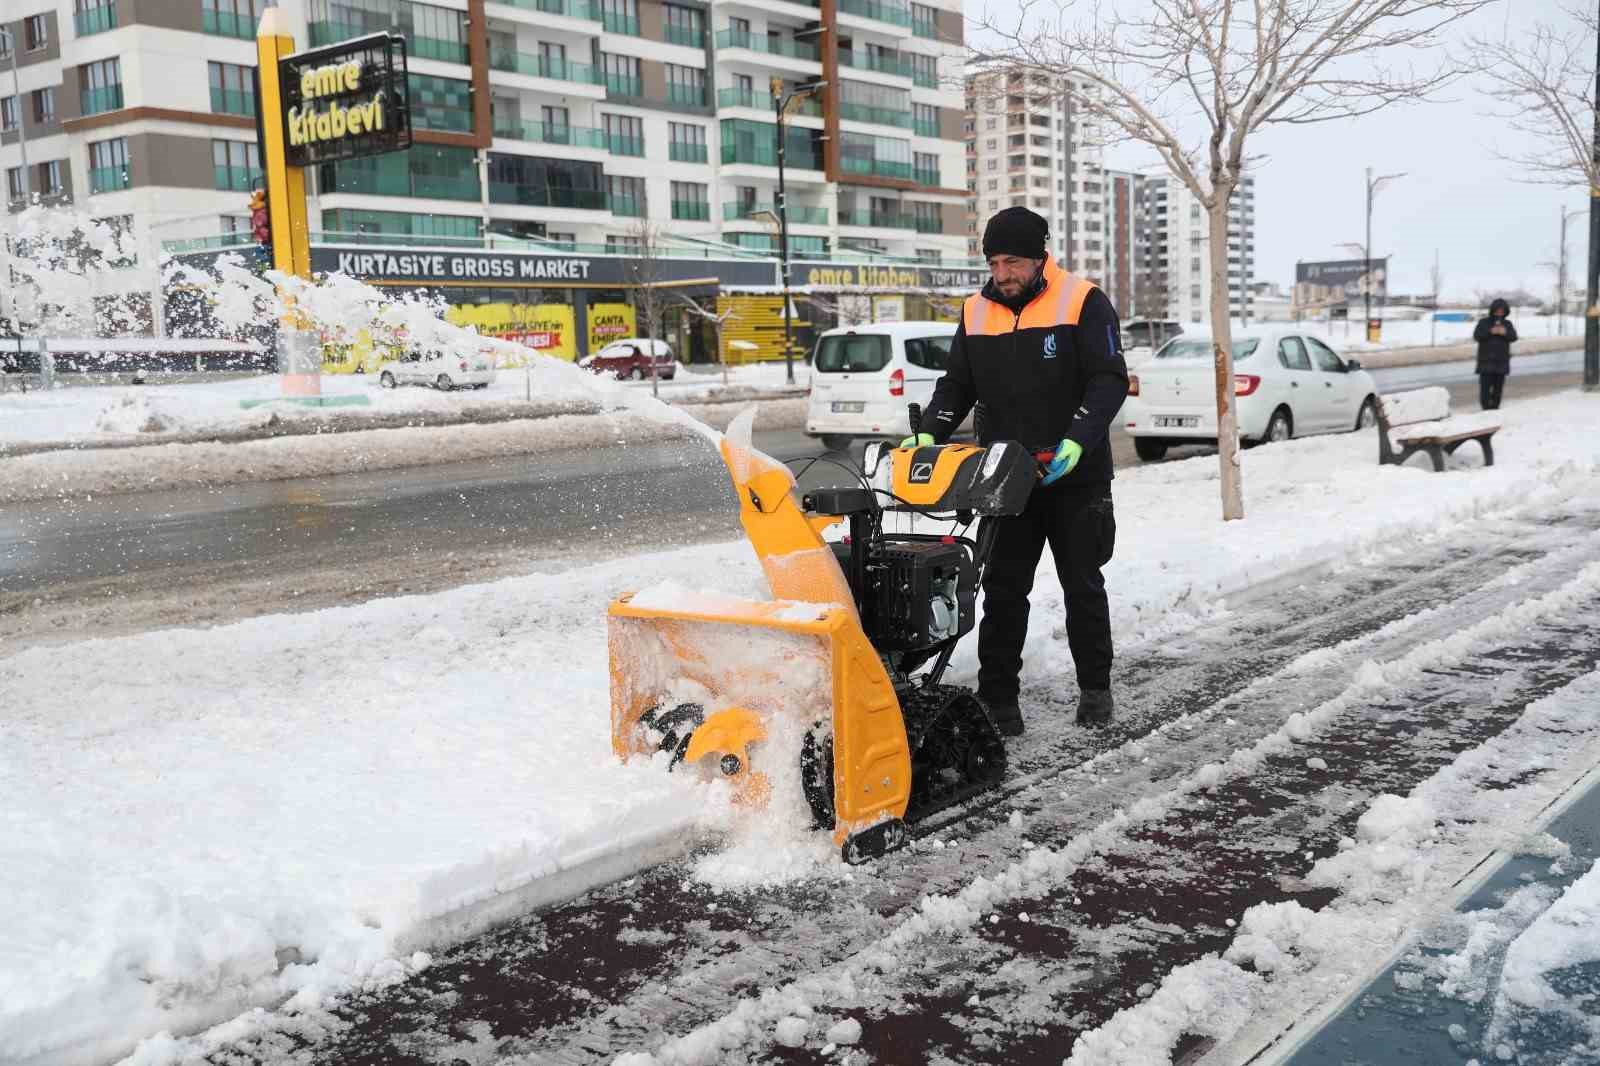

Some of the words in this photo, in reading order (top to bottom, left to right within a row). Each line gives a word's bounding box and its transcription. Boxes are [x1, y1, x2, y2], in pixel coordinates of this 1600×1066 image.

[301, 60, 361, 98] emre
[288, 91, 383, 146] kitabevi
[451, 257, 515, 278] GROSS
[519, 259, 591, 279] MARKET
[809, 267, 853, 288] emre
